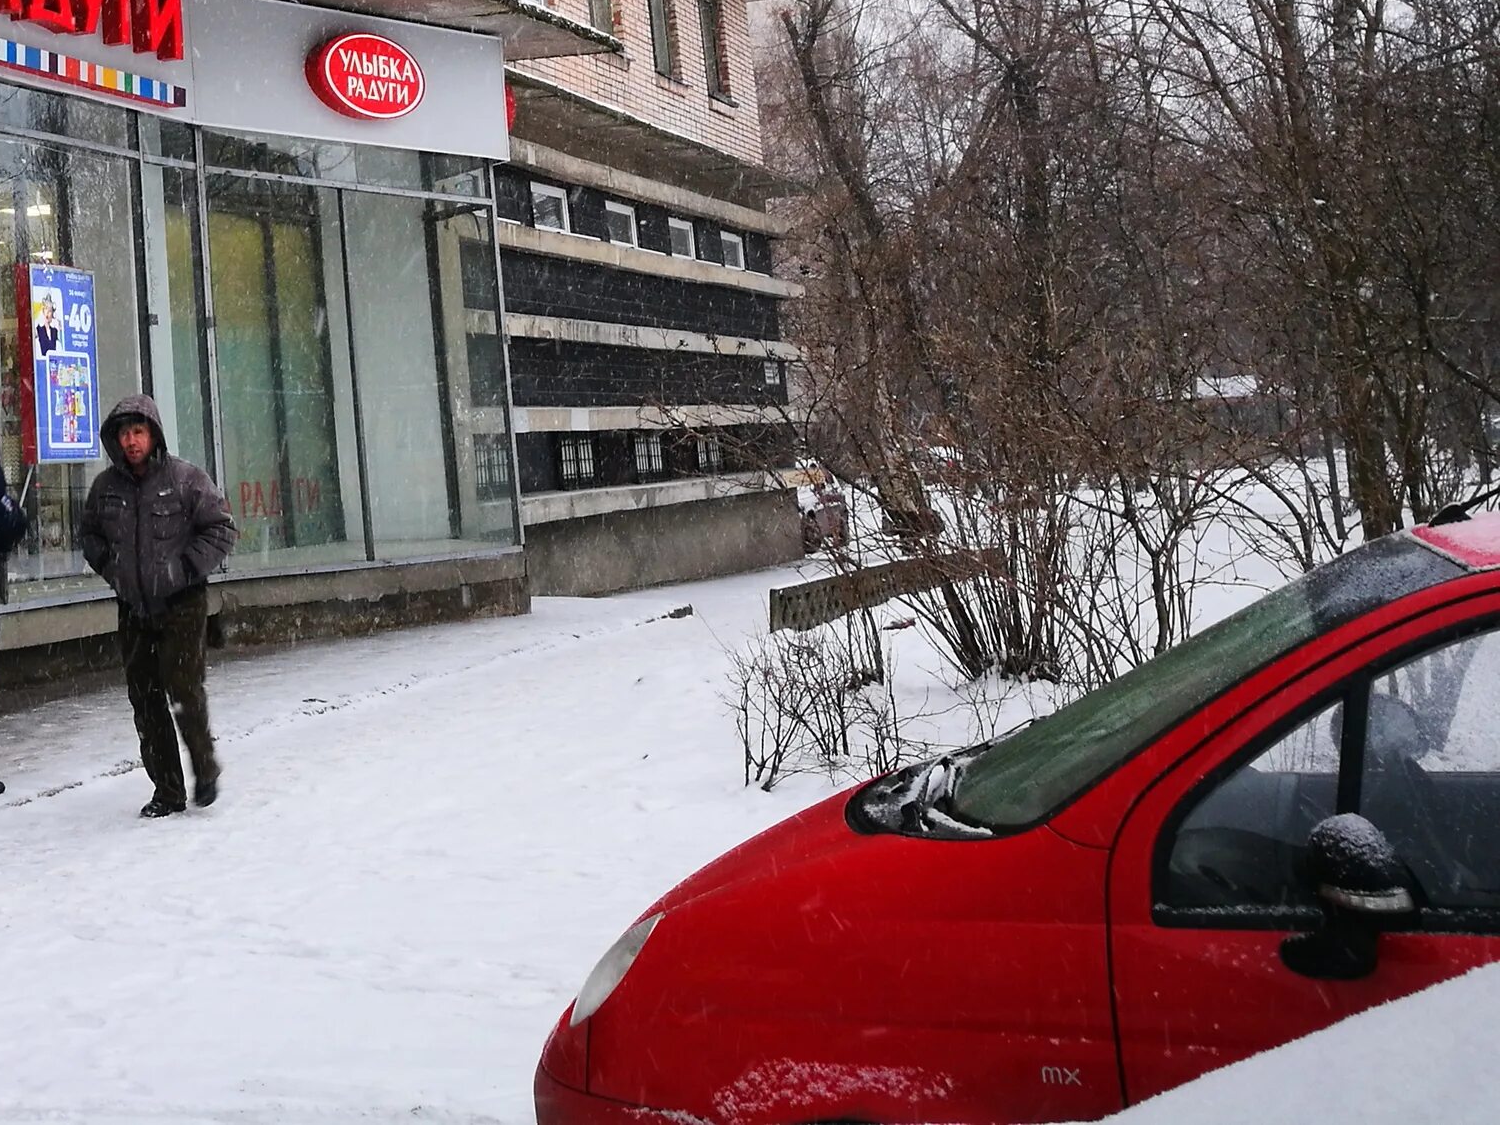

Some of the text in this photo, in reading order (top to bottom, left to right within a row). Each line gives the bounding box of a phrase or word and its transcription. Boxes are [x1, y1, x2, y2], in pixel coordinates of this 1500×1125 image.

[338, 48, 415, 83] УЛЫБКА
[347, 76, 409, 105] РАДУГИ
[64, 303, 92, 333] -40
[240, 477, 321, 522] РАДГИ
